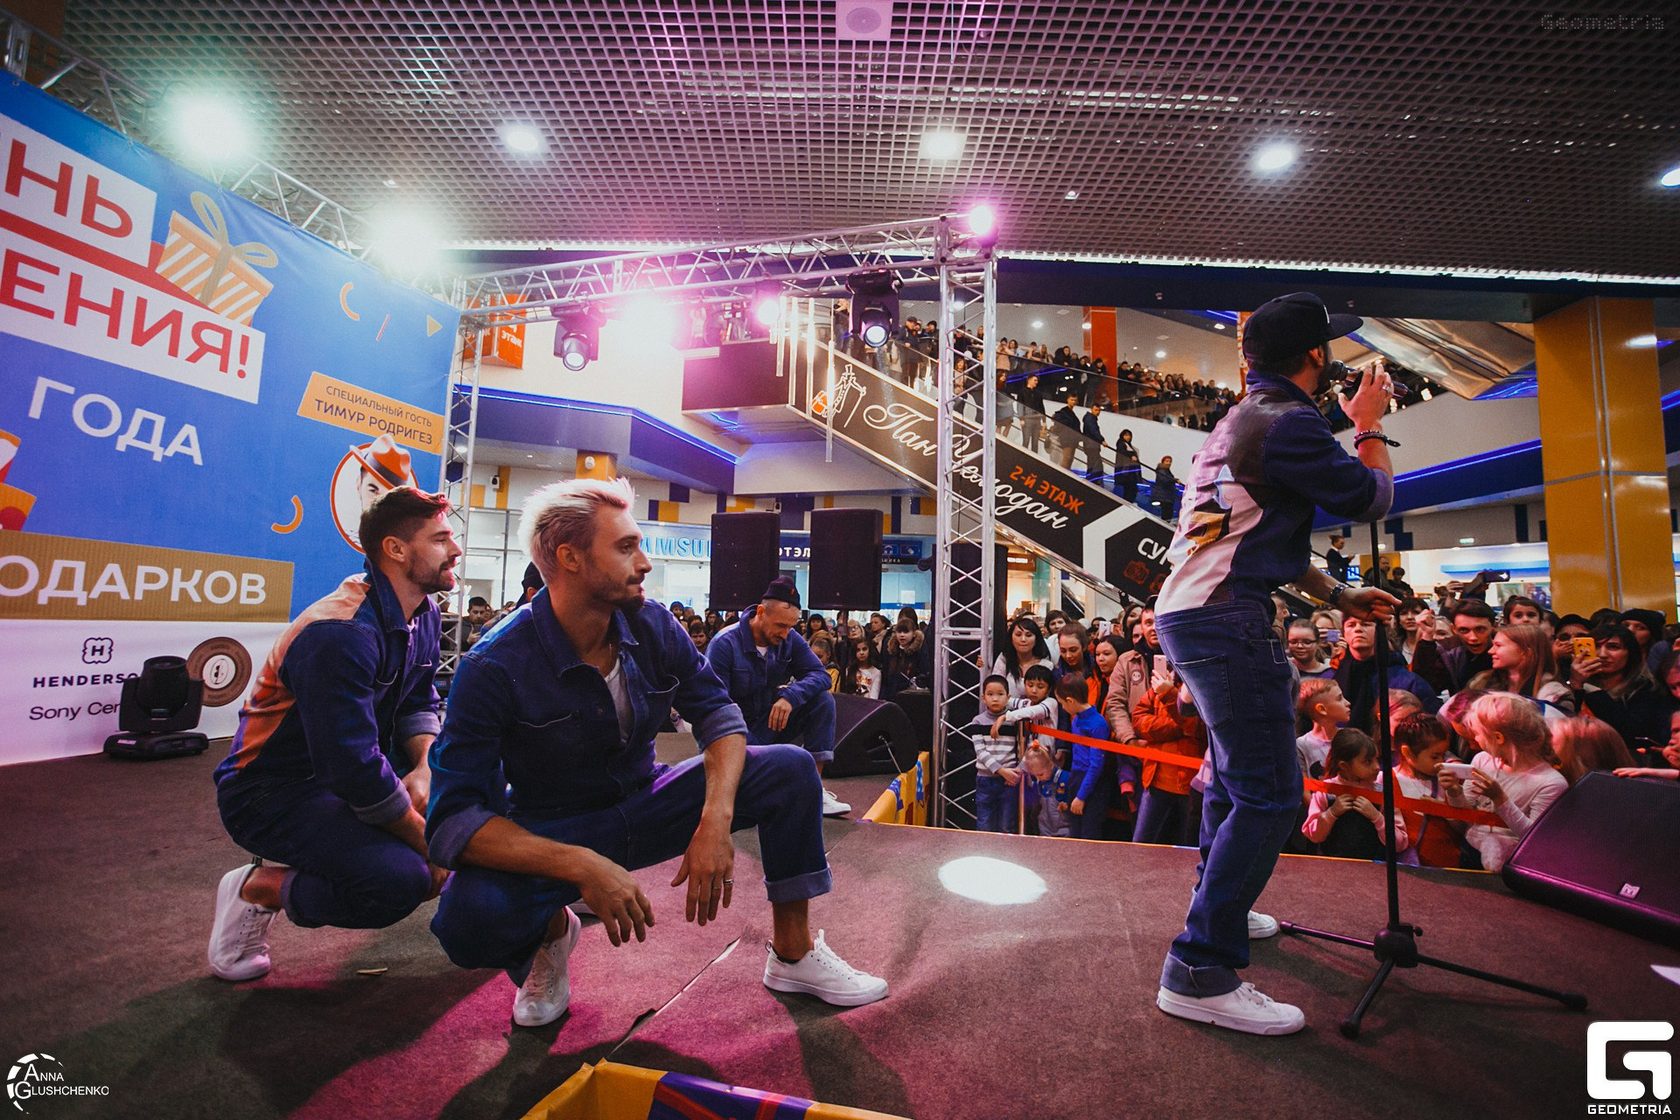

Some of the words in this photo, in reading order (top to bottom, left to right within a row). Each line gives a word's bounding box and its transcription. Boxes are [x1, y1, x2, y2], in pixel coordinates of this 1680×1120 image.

[4, 137, 134, 238] НЬ
[0, 248, 251, 380] ЕНИЯ!
[28, 375, 204, 466] ГОДА
[314, 398, 366, 424] ТИМУР
[368, 416, 433, 445] РОДРИГЕЗ
[325, 385, 403, 418] СПЕЦИАЛЬНЫЙ
[404, 411, 432, 428] ГОСТЬ
[862, 403, 938, 457] Пан
[951, 433, 1070, 530] Чеодан
[1036, 480, 1086, 515] ЭТАЖ
[0, 555, 267, 606] ОДАРКОВ
[29, 704, 82, 722] Sony
